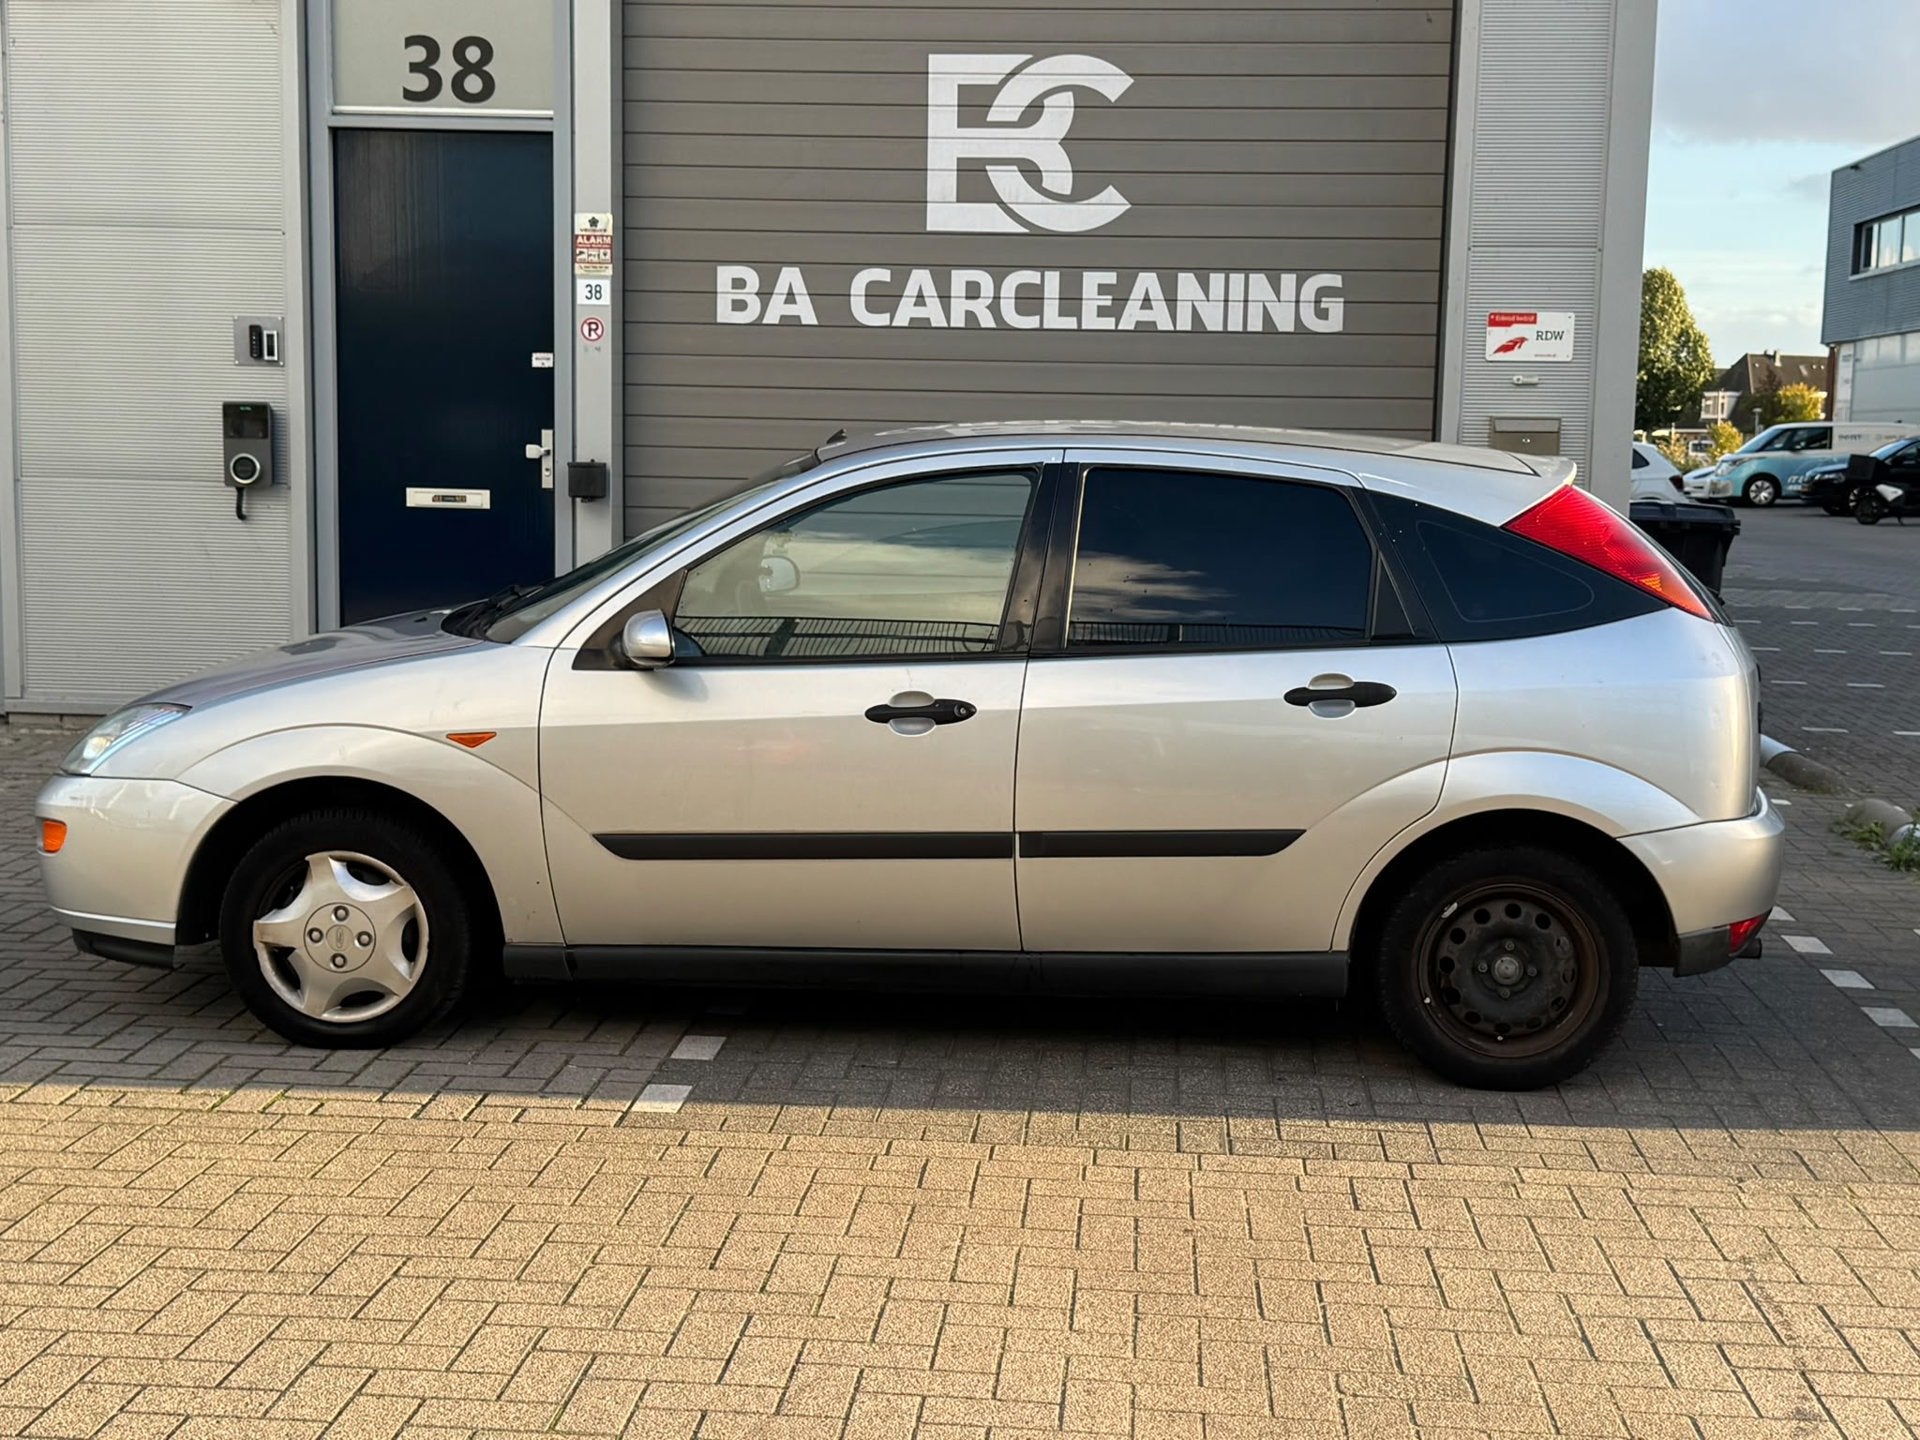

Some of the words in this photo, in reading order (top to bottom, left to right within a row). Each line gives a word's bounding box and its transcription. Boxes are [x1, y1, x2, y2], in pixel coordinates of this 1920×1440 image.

[403, 35, 496, 103] 38
[577, 235, 611, 244] ALARM
[585, 284, 602, 301] 38
[716, 265, 819, 325] BA
[850, 267, 1344, 333] CARCLEANING
[1535, 330, 1565, 341] RDW
